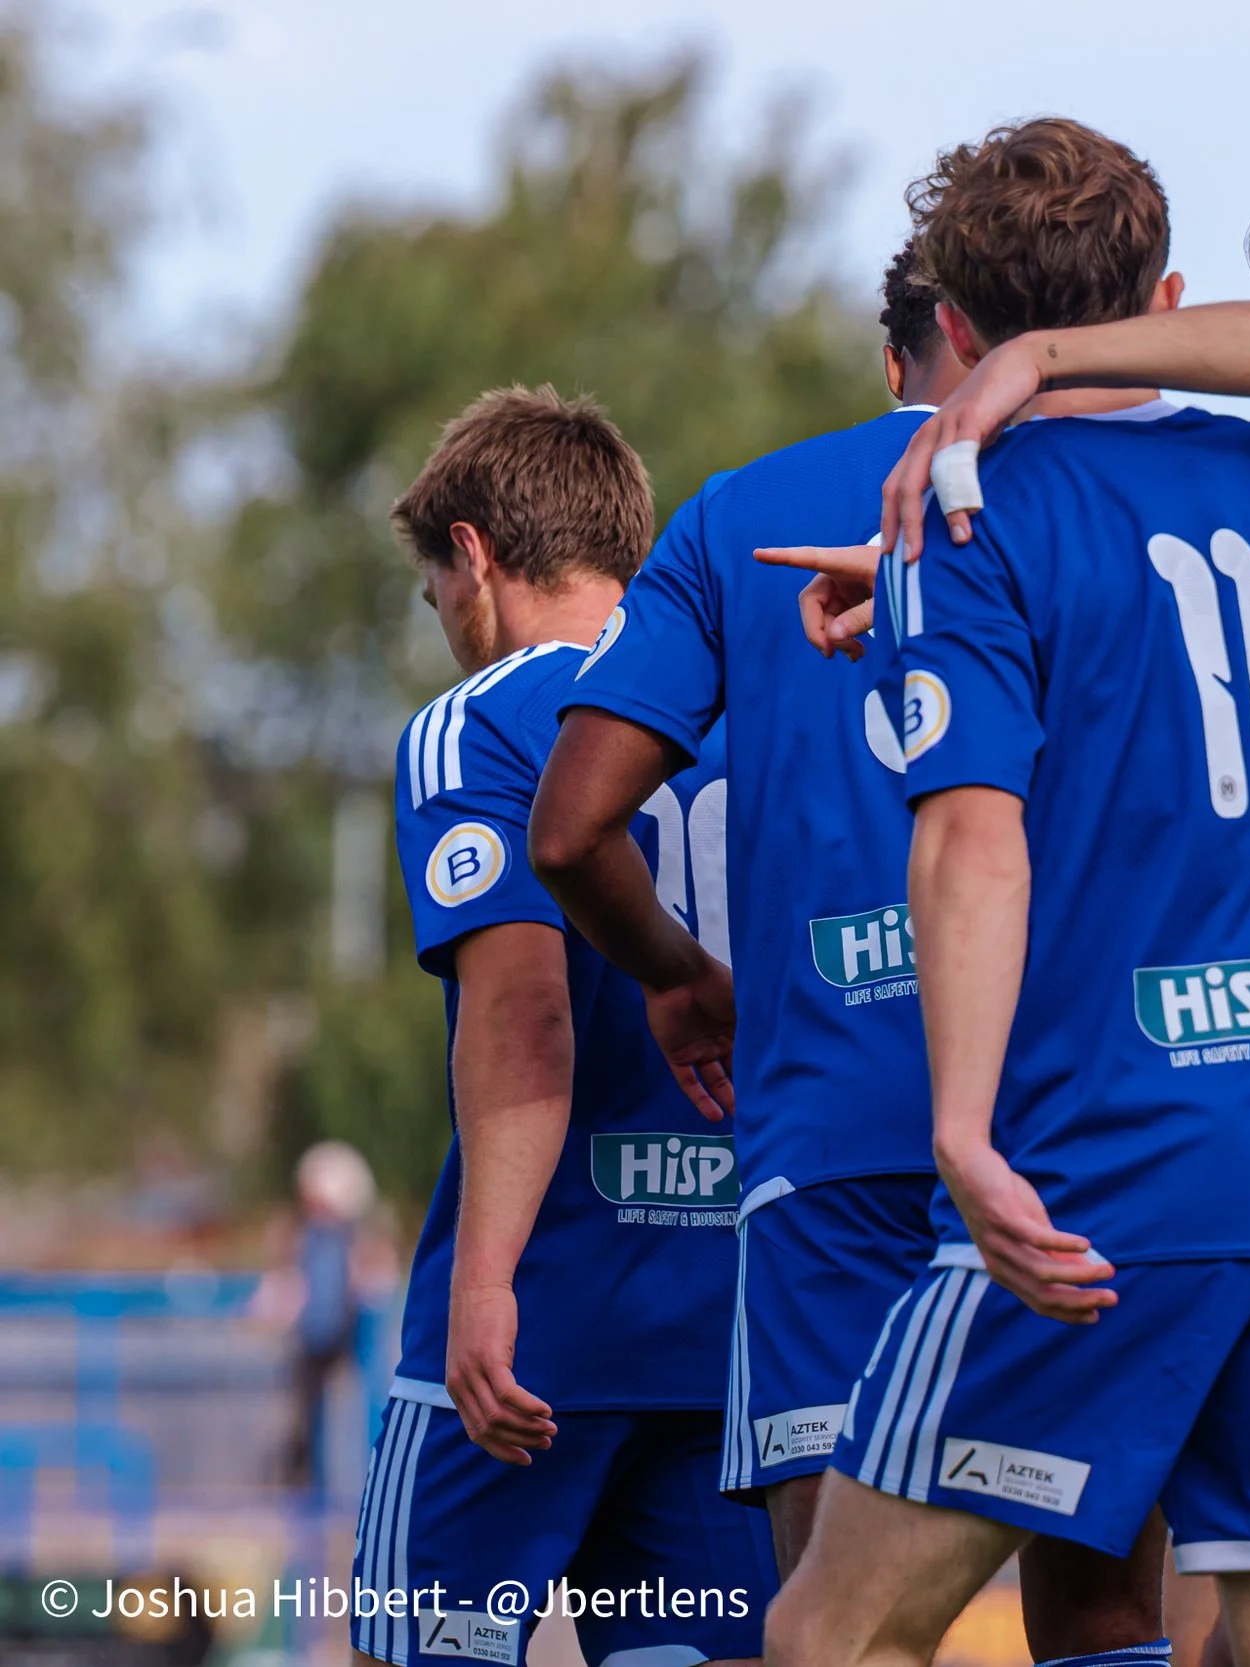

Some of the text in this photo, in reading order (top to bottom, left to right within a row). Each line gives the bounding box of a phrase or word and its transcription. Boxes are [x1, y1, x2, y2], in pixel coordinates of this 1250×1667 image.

[447, 846, 481, 887] B
[845, 980, 919, 1006] LIFE SAFETY
[1169, 1048, 1201, 1068] LIFE
[1202, 1043, 1250, 1065] SAFETY
[620, 1137, 742, 1200] HiSP
[618, 1209, 645, 1224] LIFE
[648, 1209, 680, 1226] SAFETY
[791, 1420, 829, 1436] AZTEK
[791, 1444, 805, 1454] 0330
[806, 1443, 820, 1452] 043
[1006, 1463, 1055, 1485] AZTEK
[474, 1627, 509, 1641] AZTEK
